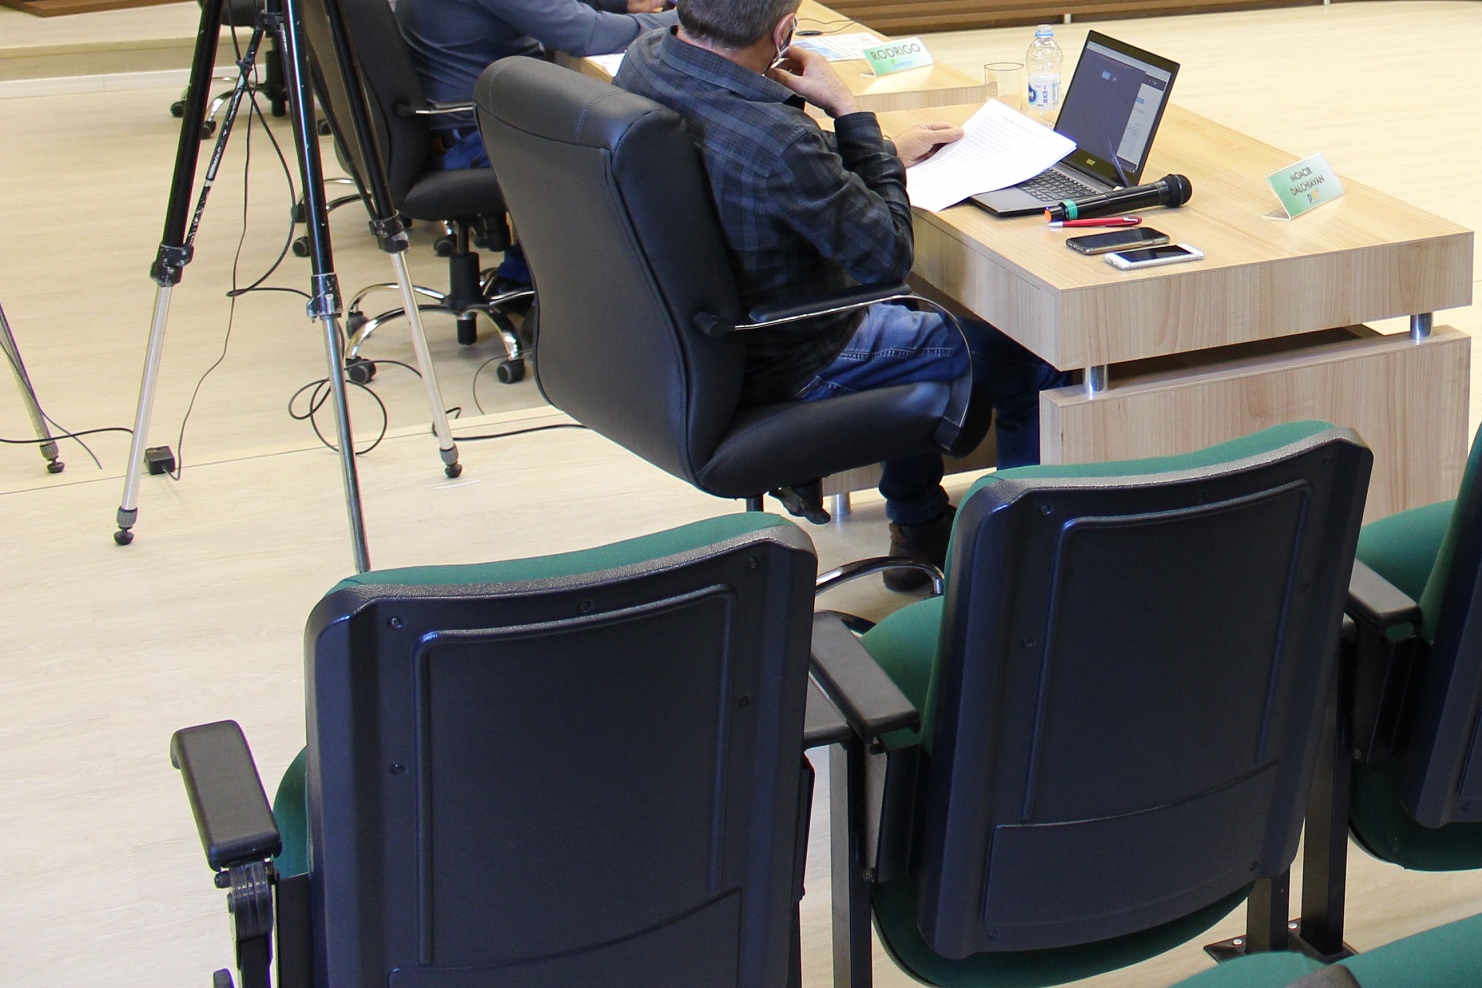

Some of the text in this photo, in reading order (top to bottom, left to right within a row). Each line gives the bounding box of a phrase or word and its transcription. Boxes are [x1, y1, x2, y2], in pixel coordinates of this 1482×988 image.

[870, 43, 921, 61] RODRIGO
[1289, 166, 1313, 182] MOACIR
[1289, 174, 1326, 197] DALCHIAVAN
